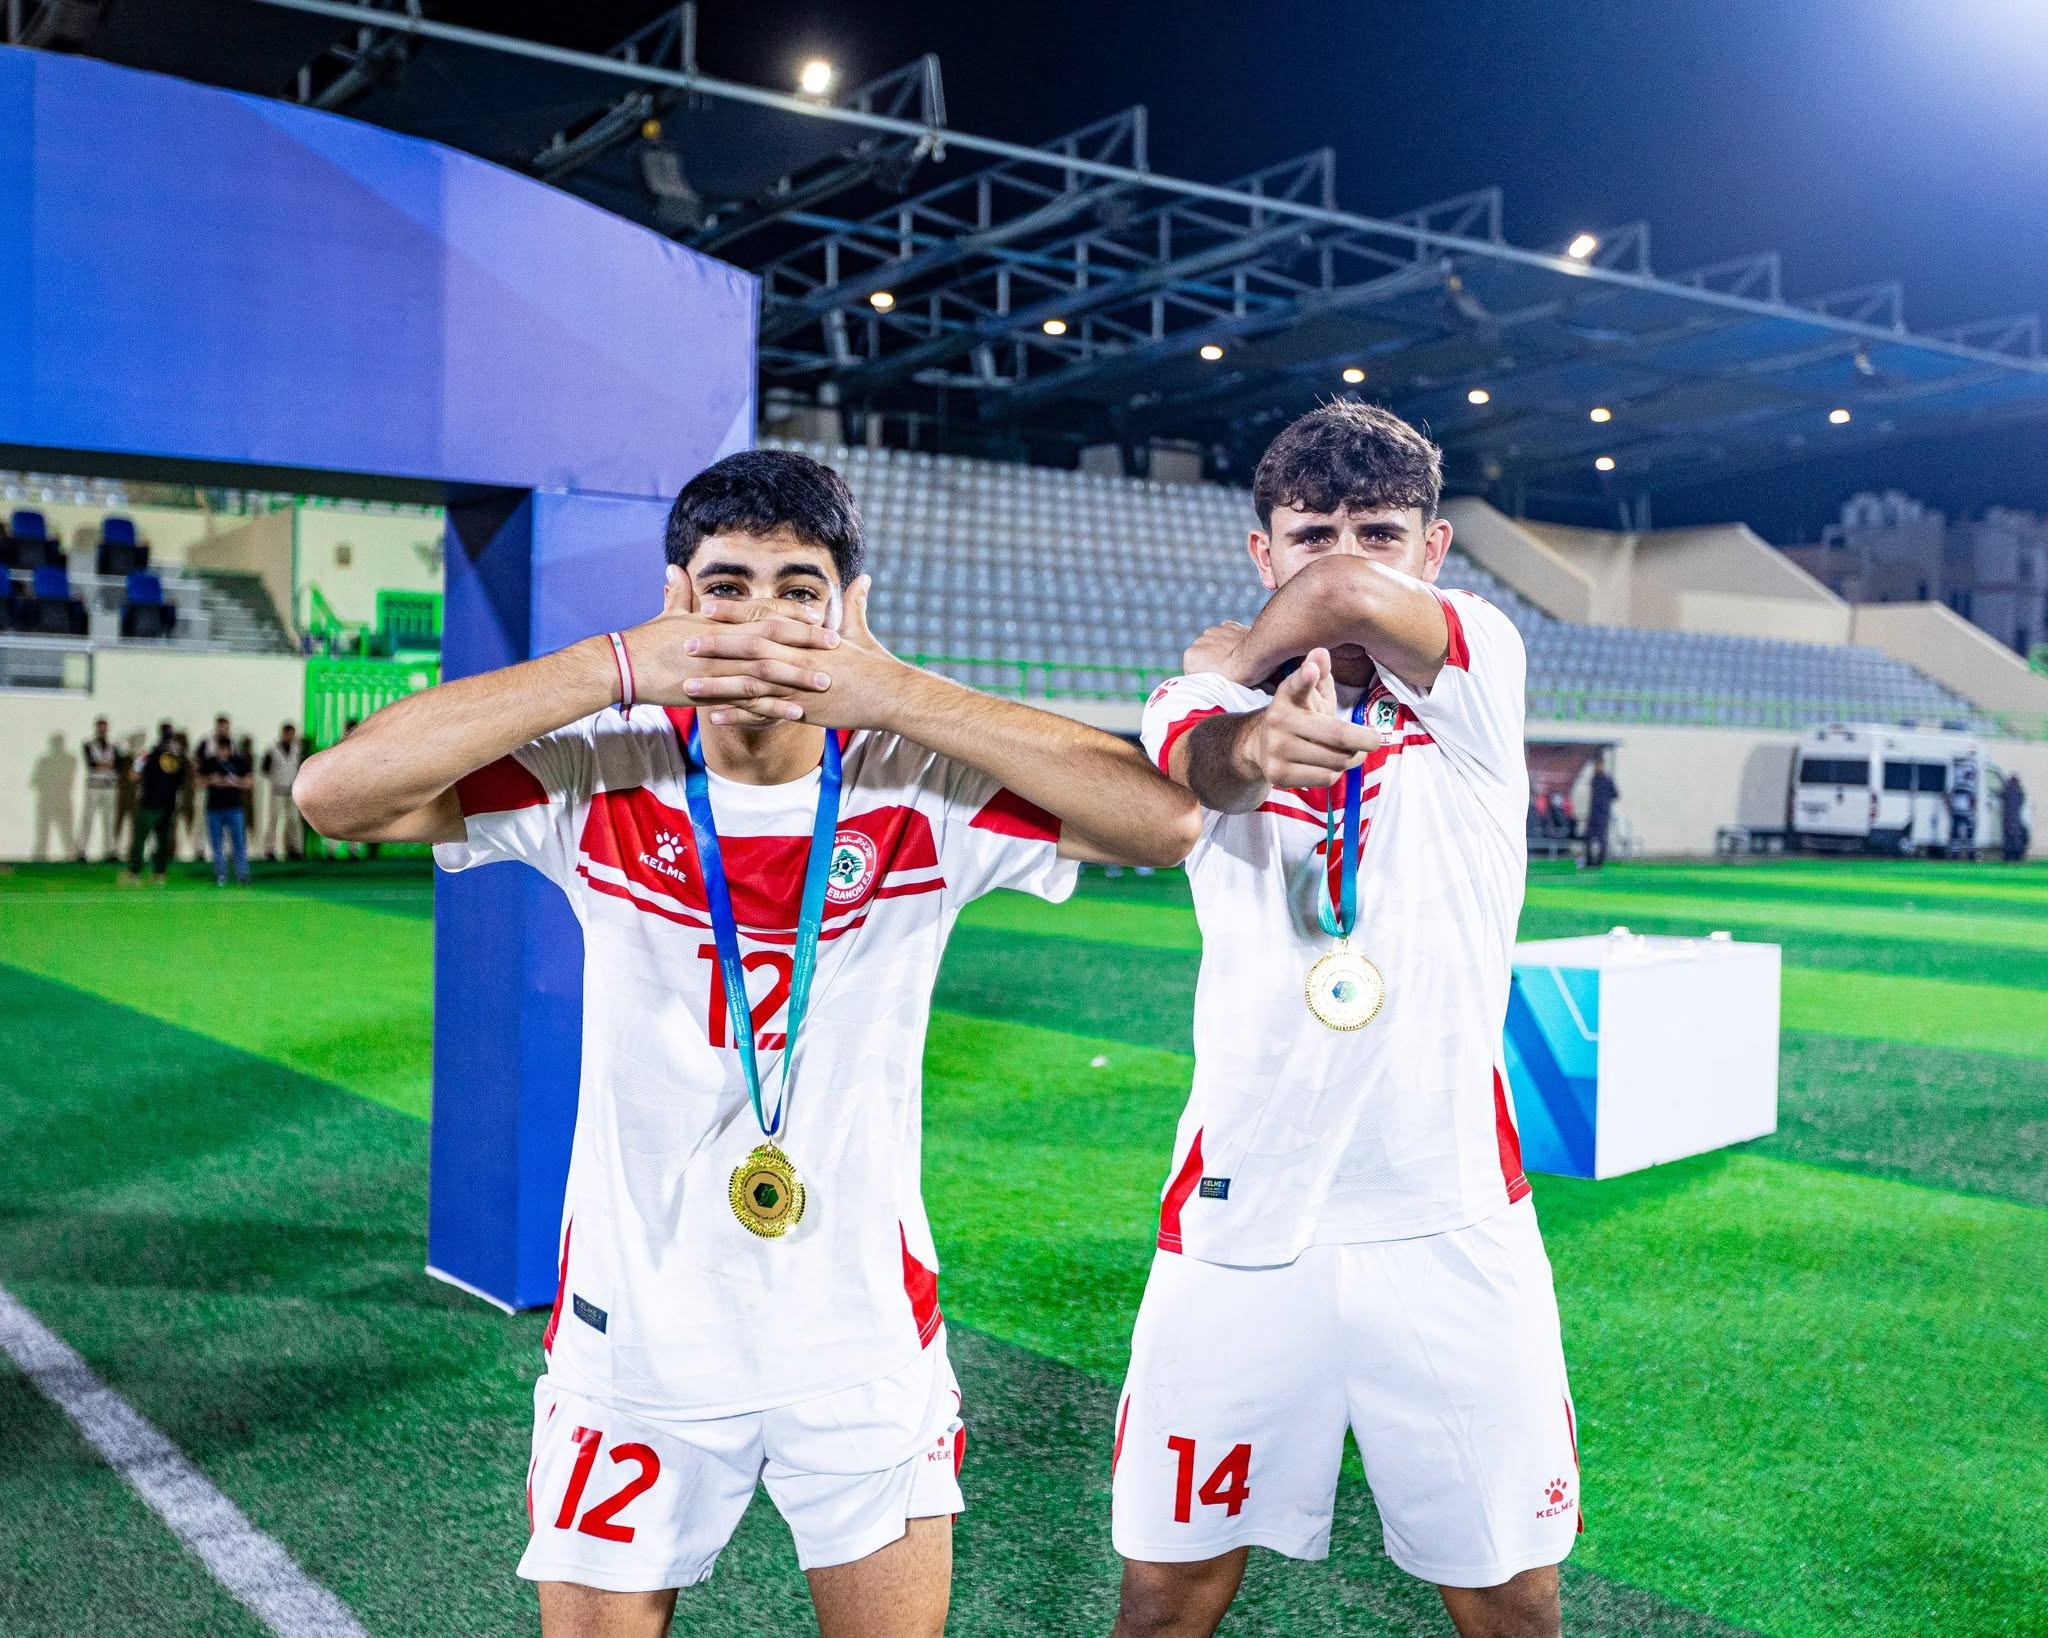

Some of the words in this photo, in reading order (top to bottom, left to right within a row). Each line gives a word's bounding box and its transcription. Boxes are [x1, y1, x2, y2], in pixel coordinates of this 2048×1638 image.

[639, 851, 687, 883] KELME
[826, 884, 865, 900] EBANON
[697, 944, 795, 1051] 12
[554, 1426, 661, 1543] 12
[1167, 1435, 1252, 1523] 14
[1536, 1499, 1574, 1519] KELME
